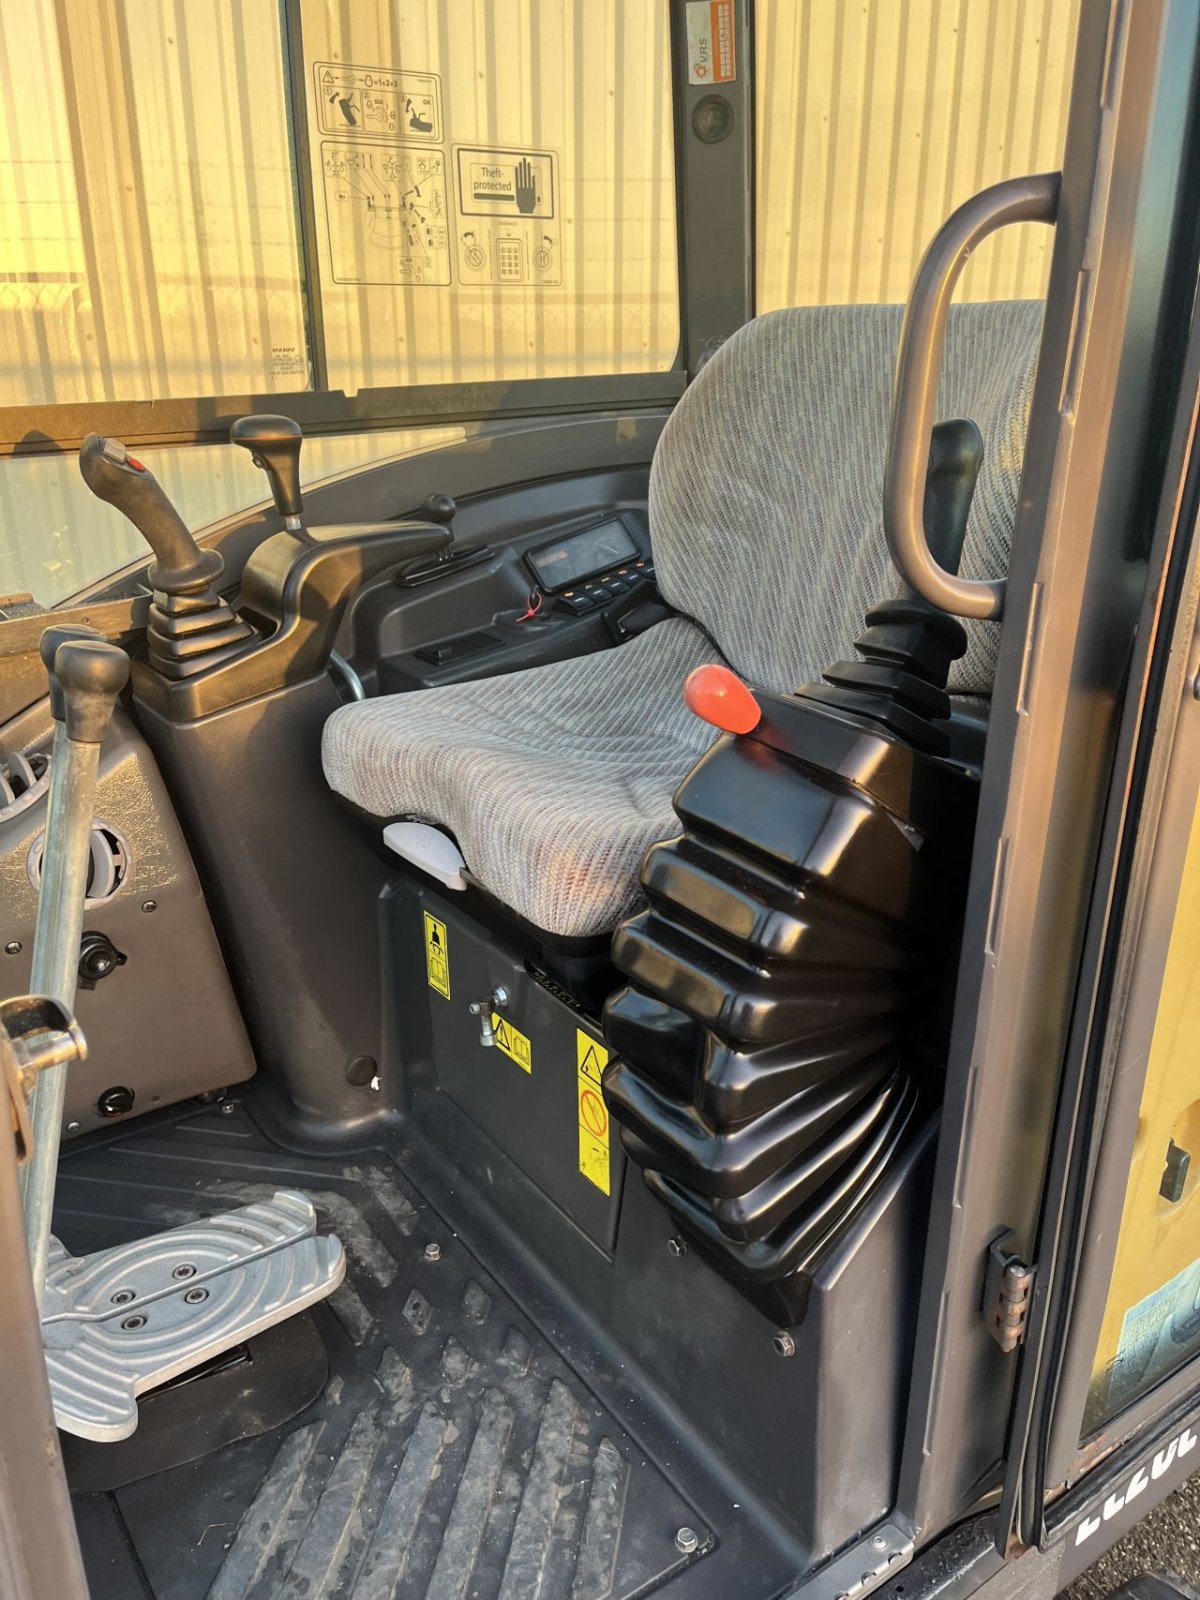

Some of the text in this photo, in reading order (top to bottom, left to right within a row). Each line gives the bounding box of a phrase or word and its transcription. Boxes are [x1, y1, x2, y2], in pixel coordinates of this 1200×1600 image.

[699, 37, 708, 63] VRS
[481, 166, 505, 178] Theft-
[473, 181, 512, 191] protected
